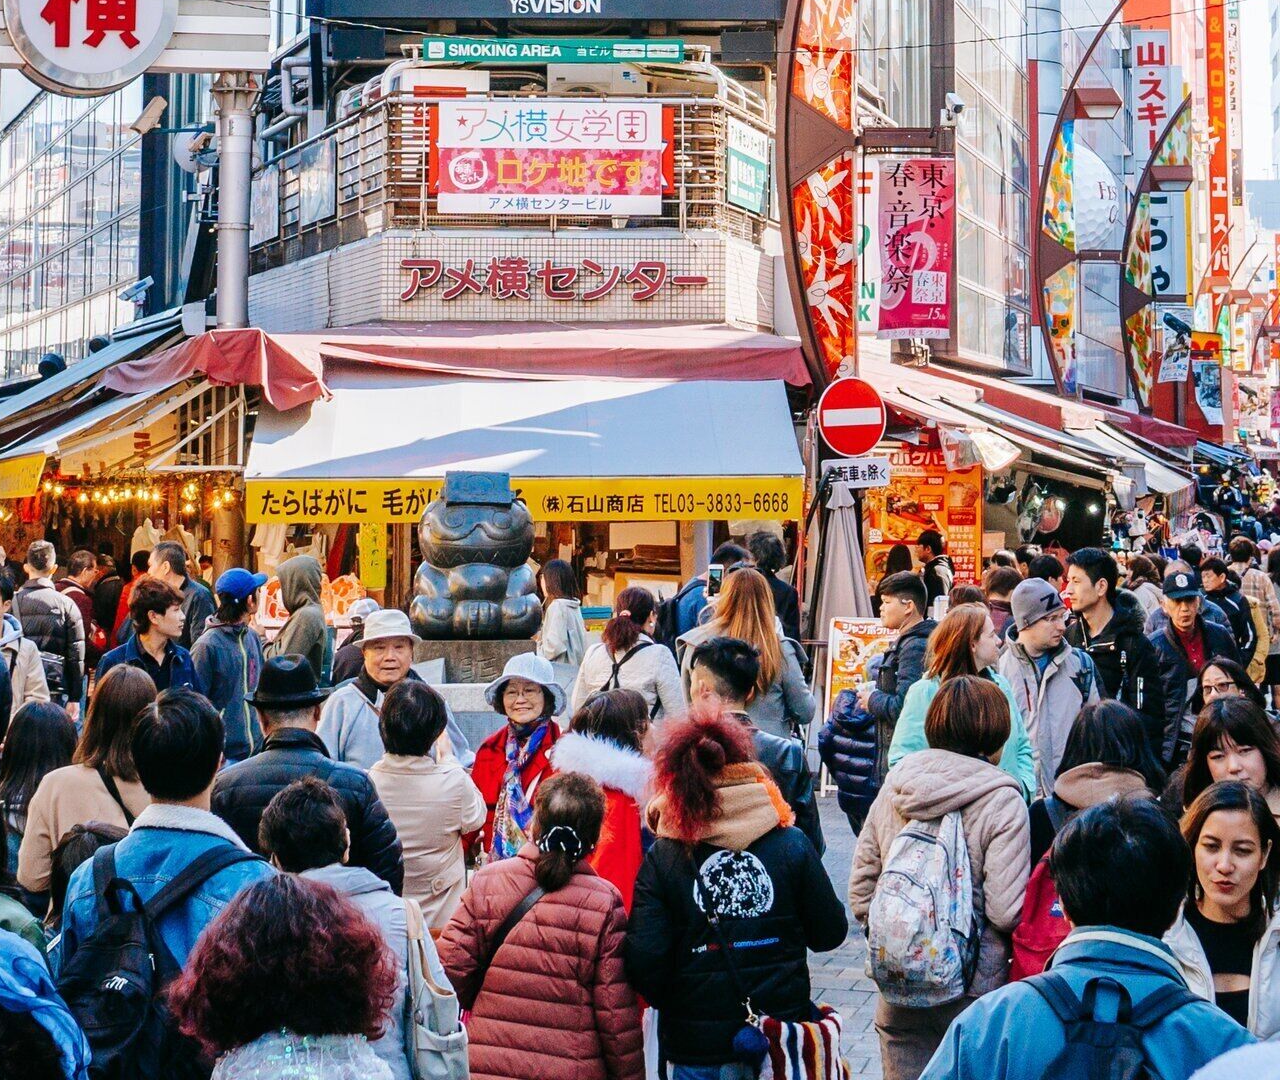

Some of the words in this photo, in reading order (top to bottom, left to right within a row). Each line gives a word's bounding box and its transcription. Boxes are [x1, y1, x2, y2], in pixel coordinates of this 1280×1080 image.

[448, 43, 517, 57] SMOKING
[521, 43, 561, 57] AREA
[455, 108, 648, 143] アメ横女学園
[497, 160, 645, 187] ロケ地です
[488, 197, 612, 211] アメ横センタービル
[399, 258, 709, 301] アメ横センター
[260, 489, 368, 515] たらばがに
